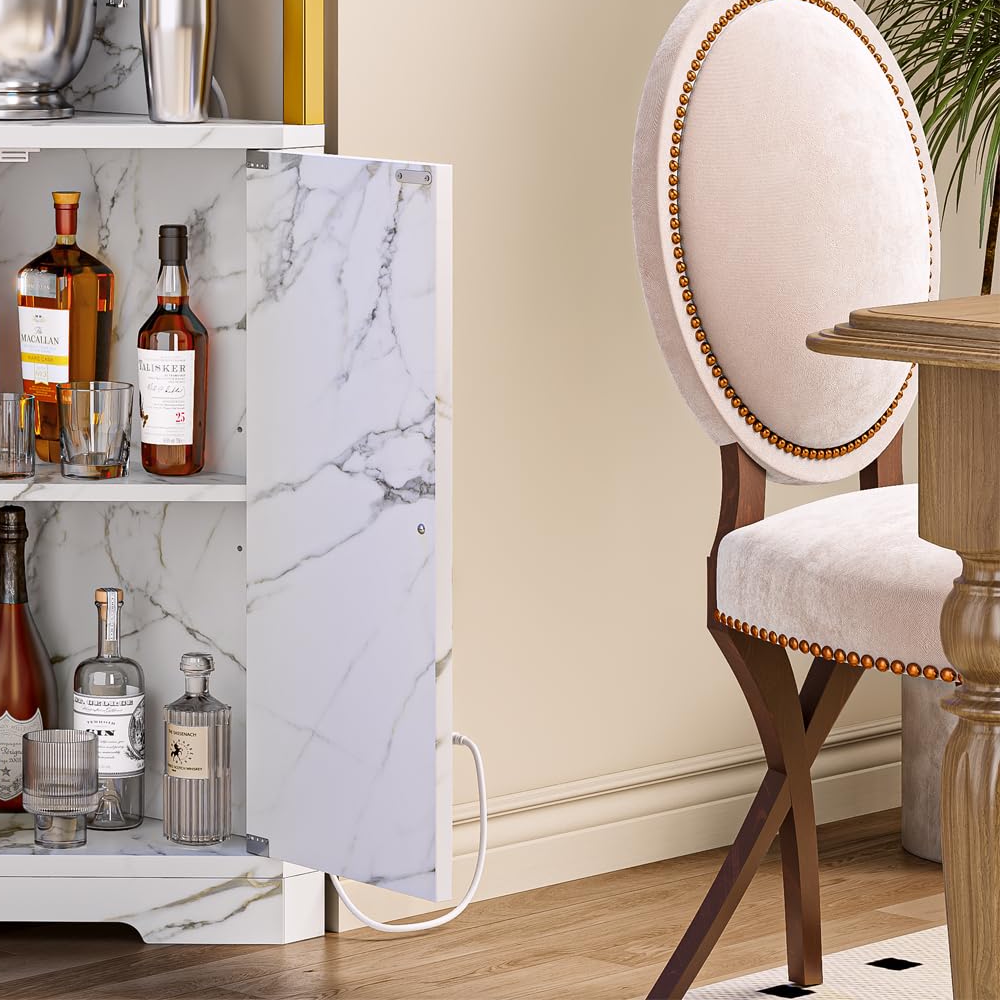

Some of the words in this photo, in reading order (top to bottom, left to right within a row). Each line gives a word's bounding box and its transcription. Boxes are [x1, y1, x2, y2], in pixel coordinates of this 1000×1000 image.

[21, 333, 59, 345] MACALLAN
[138, 359, 186, 373] TALISKER
[176, 411, 186, 423] 25
